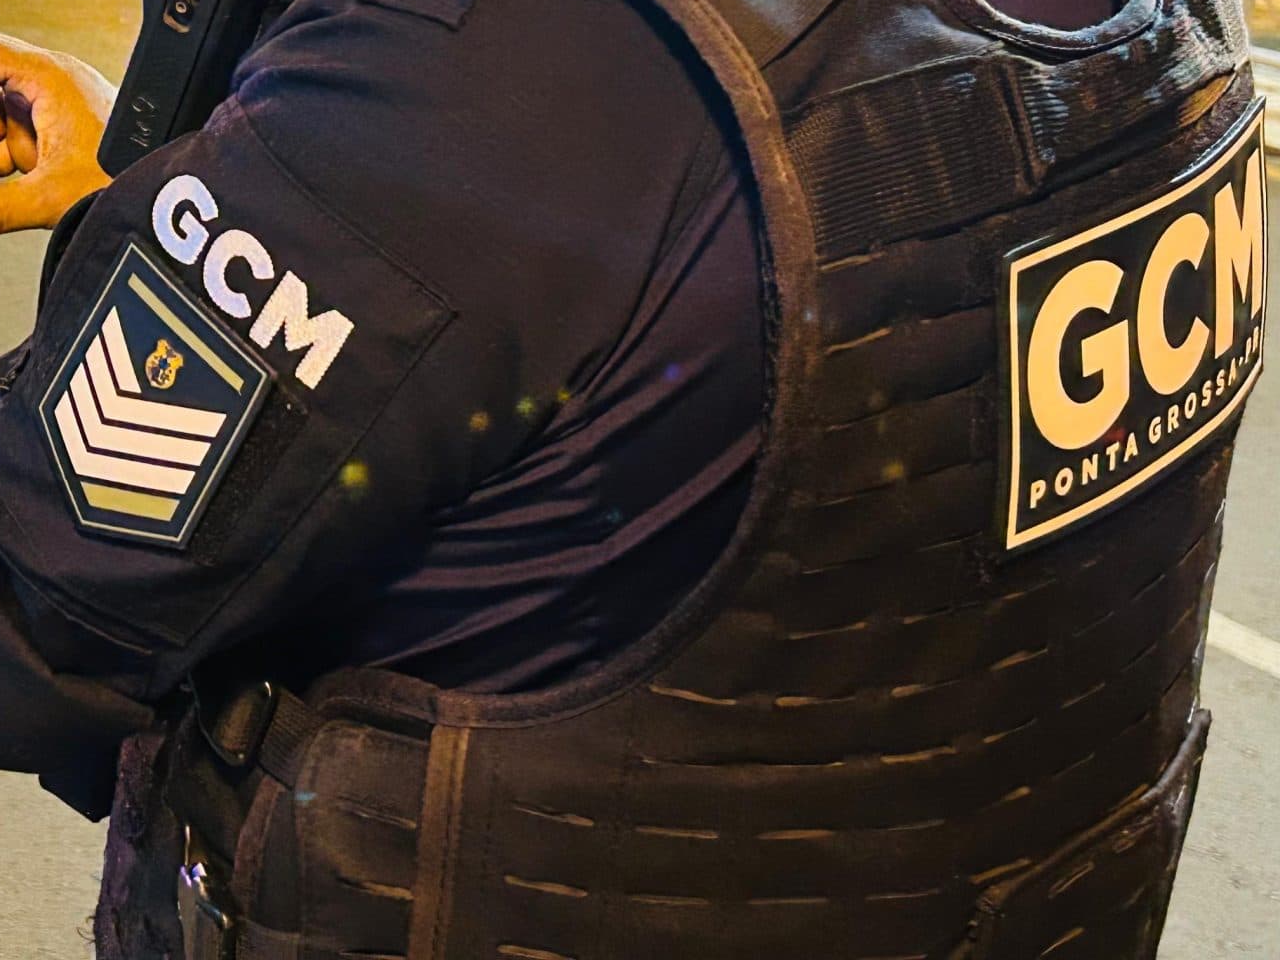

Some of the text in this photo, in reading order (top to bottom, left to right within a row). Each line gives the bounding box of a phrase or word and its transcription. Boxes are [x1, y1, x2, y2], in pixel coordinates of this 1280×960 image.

[152, 174, 355, 390] GCM
[1027, 147, 1262, 451] GCM
[1030, 431, 1140, 509] PONTA
